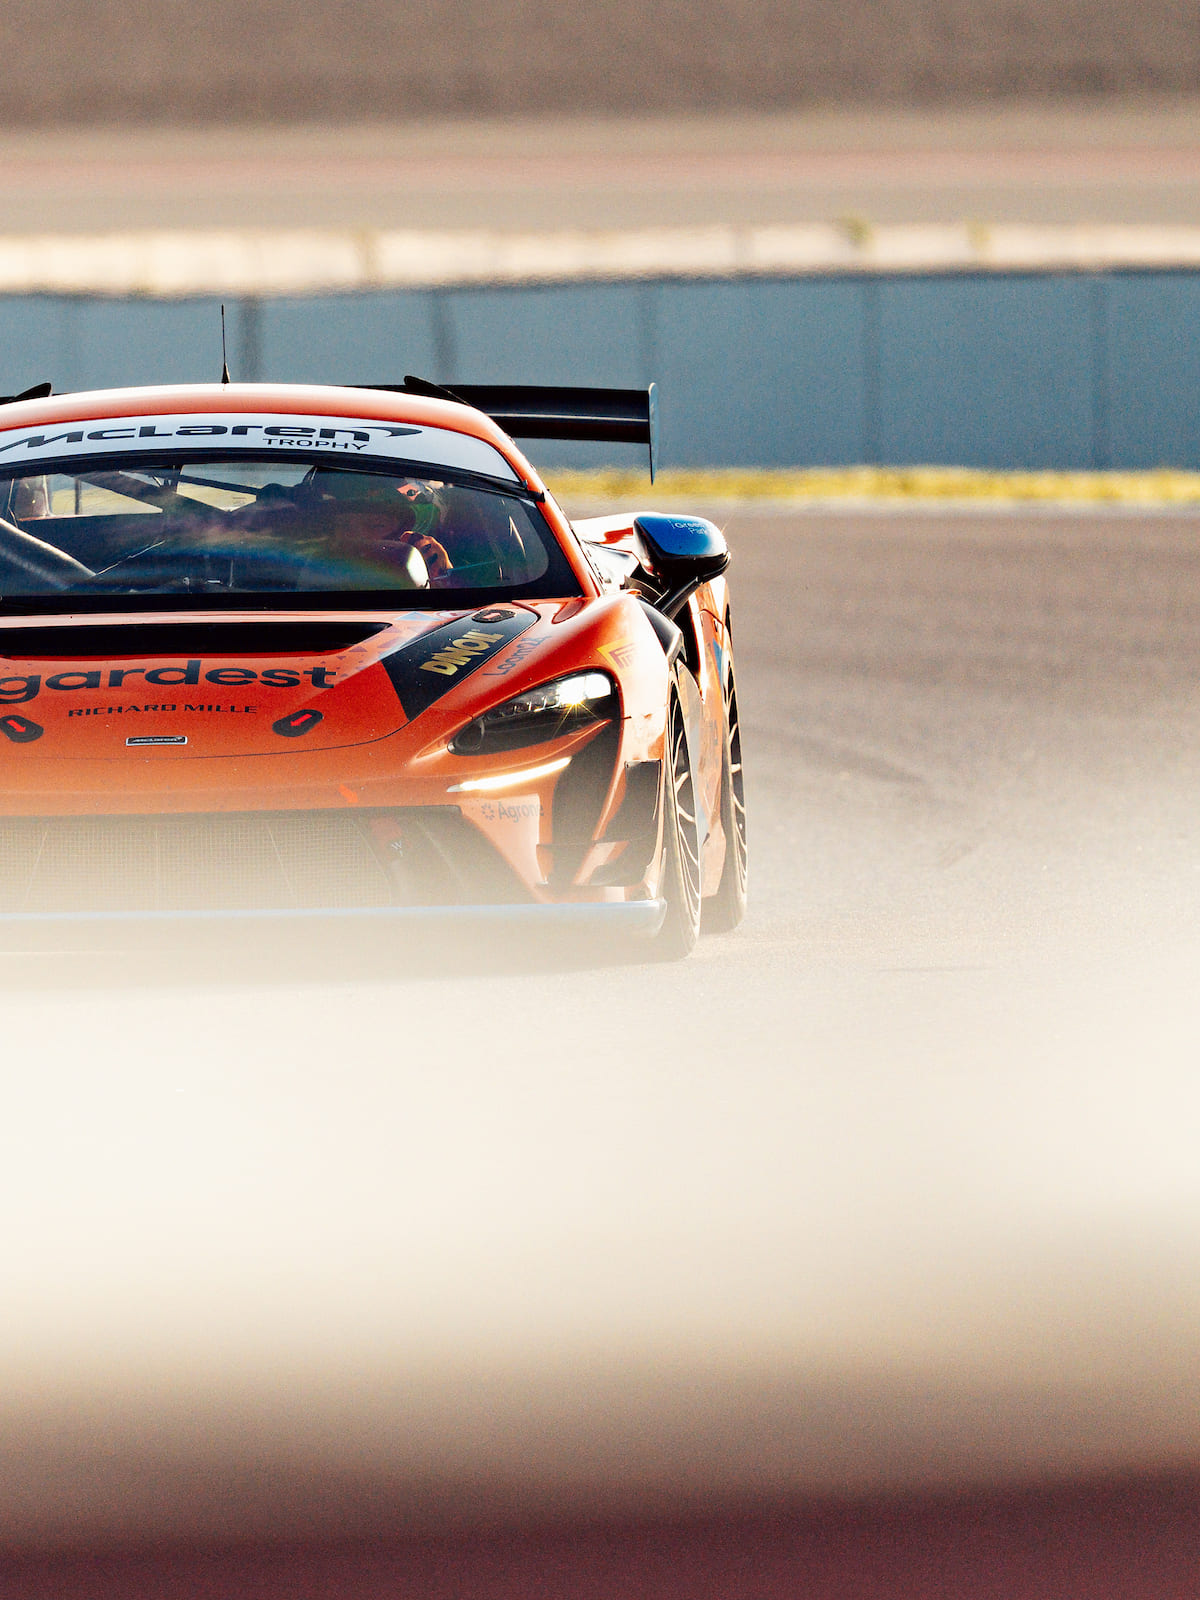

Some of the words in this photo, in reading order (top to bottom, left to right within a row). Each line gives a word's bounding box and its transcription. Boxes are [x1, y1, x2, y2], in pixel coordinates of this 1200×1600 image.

[263, 438, 368, 451] TROPHY
[419, 630, 505, 676] DINOIL
[68, 704, 177, 717] RICHARD
[184, 704, 258, 714] MILLE
